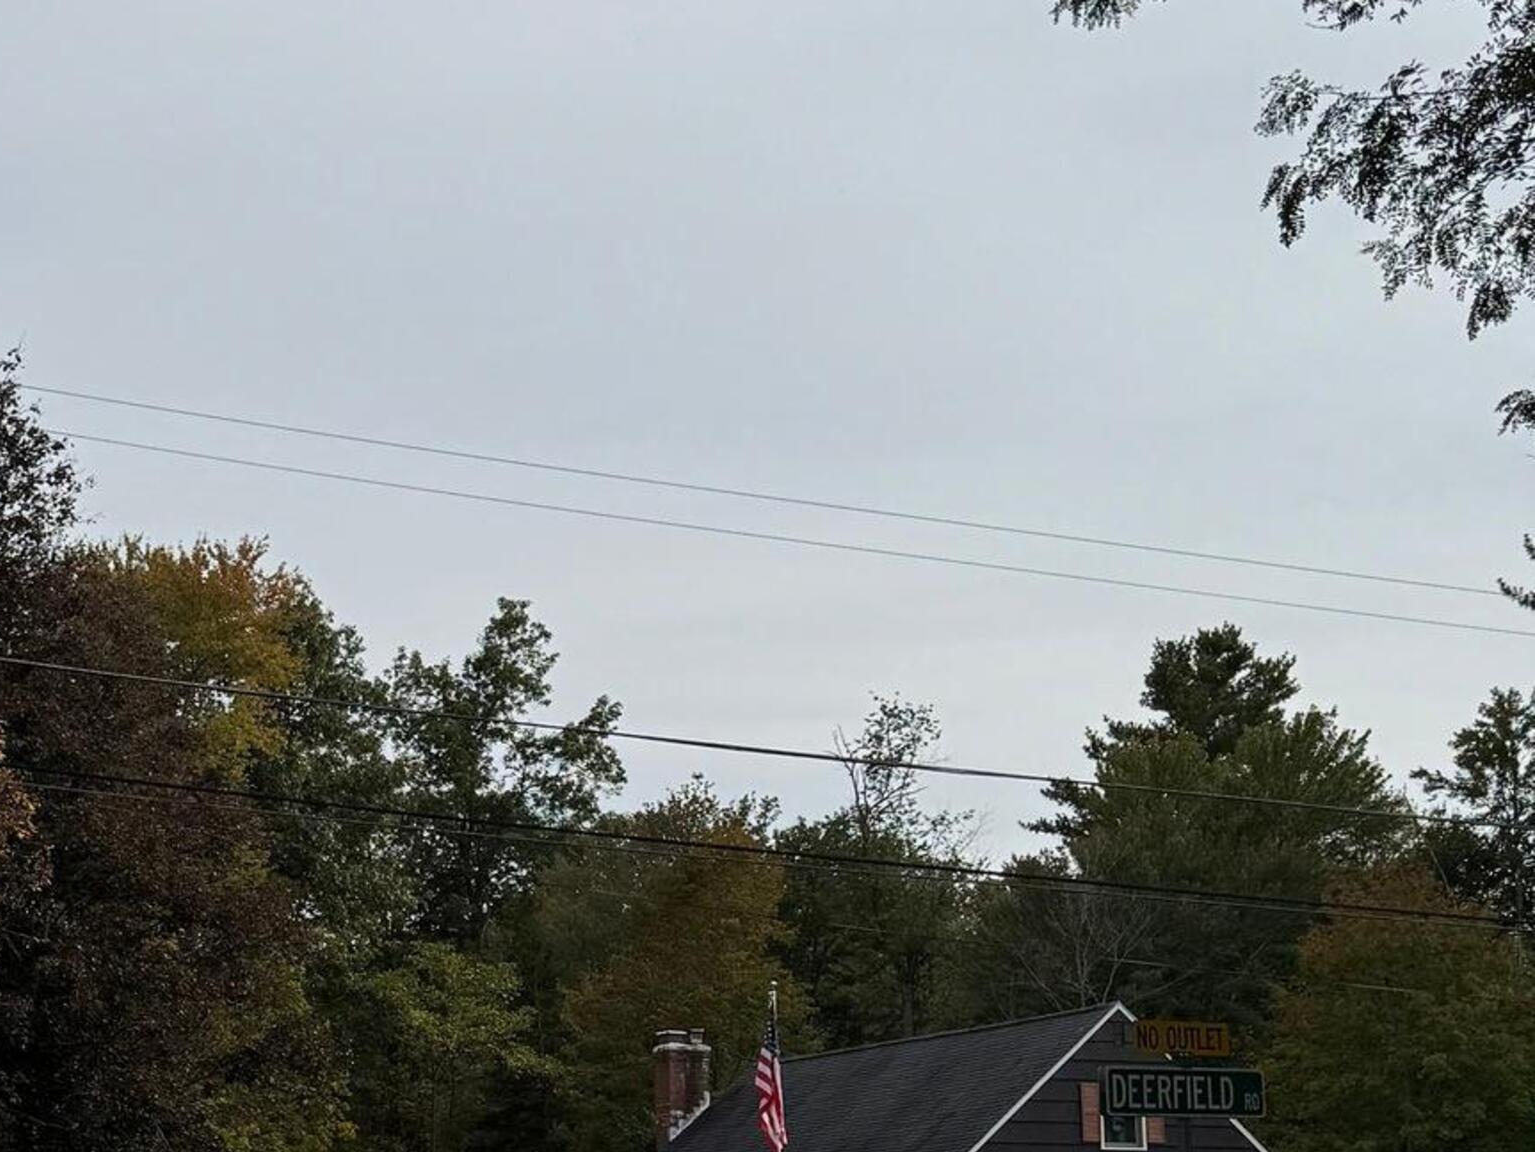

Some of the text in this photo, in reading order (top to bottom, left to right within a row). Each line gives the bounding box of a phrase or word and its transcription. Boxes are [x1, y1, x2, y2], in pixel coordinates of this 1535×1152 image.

[1136, 1025, 1223, 1050] NO OUTLET
[1112, 1074, 1260, 1111] DEERFIELD RD
